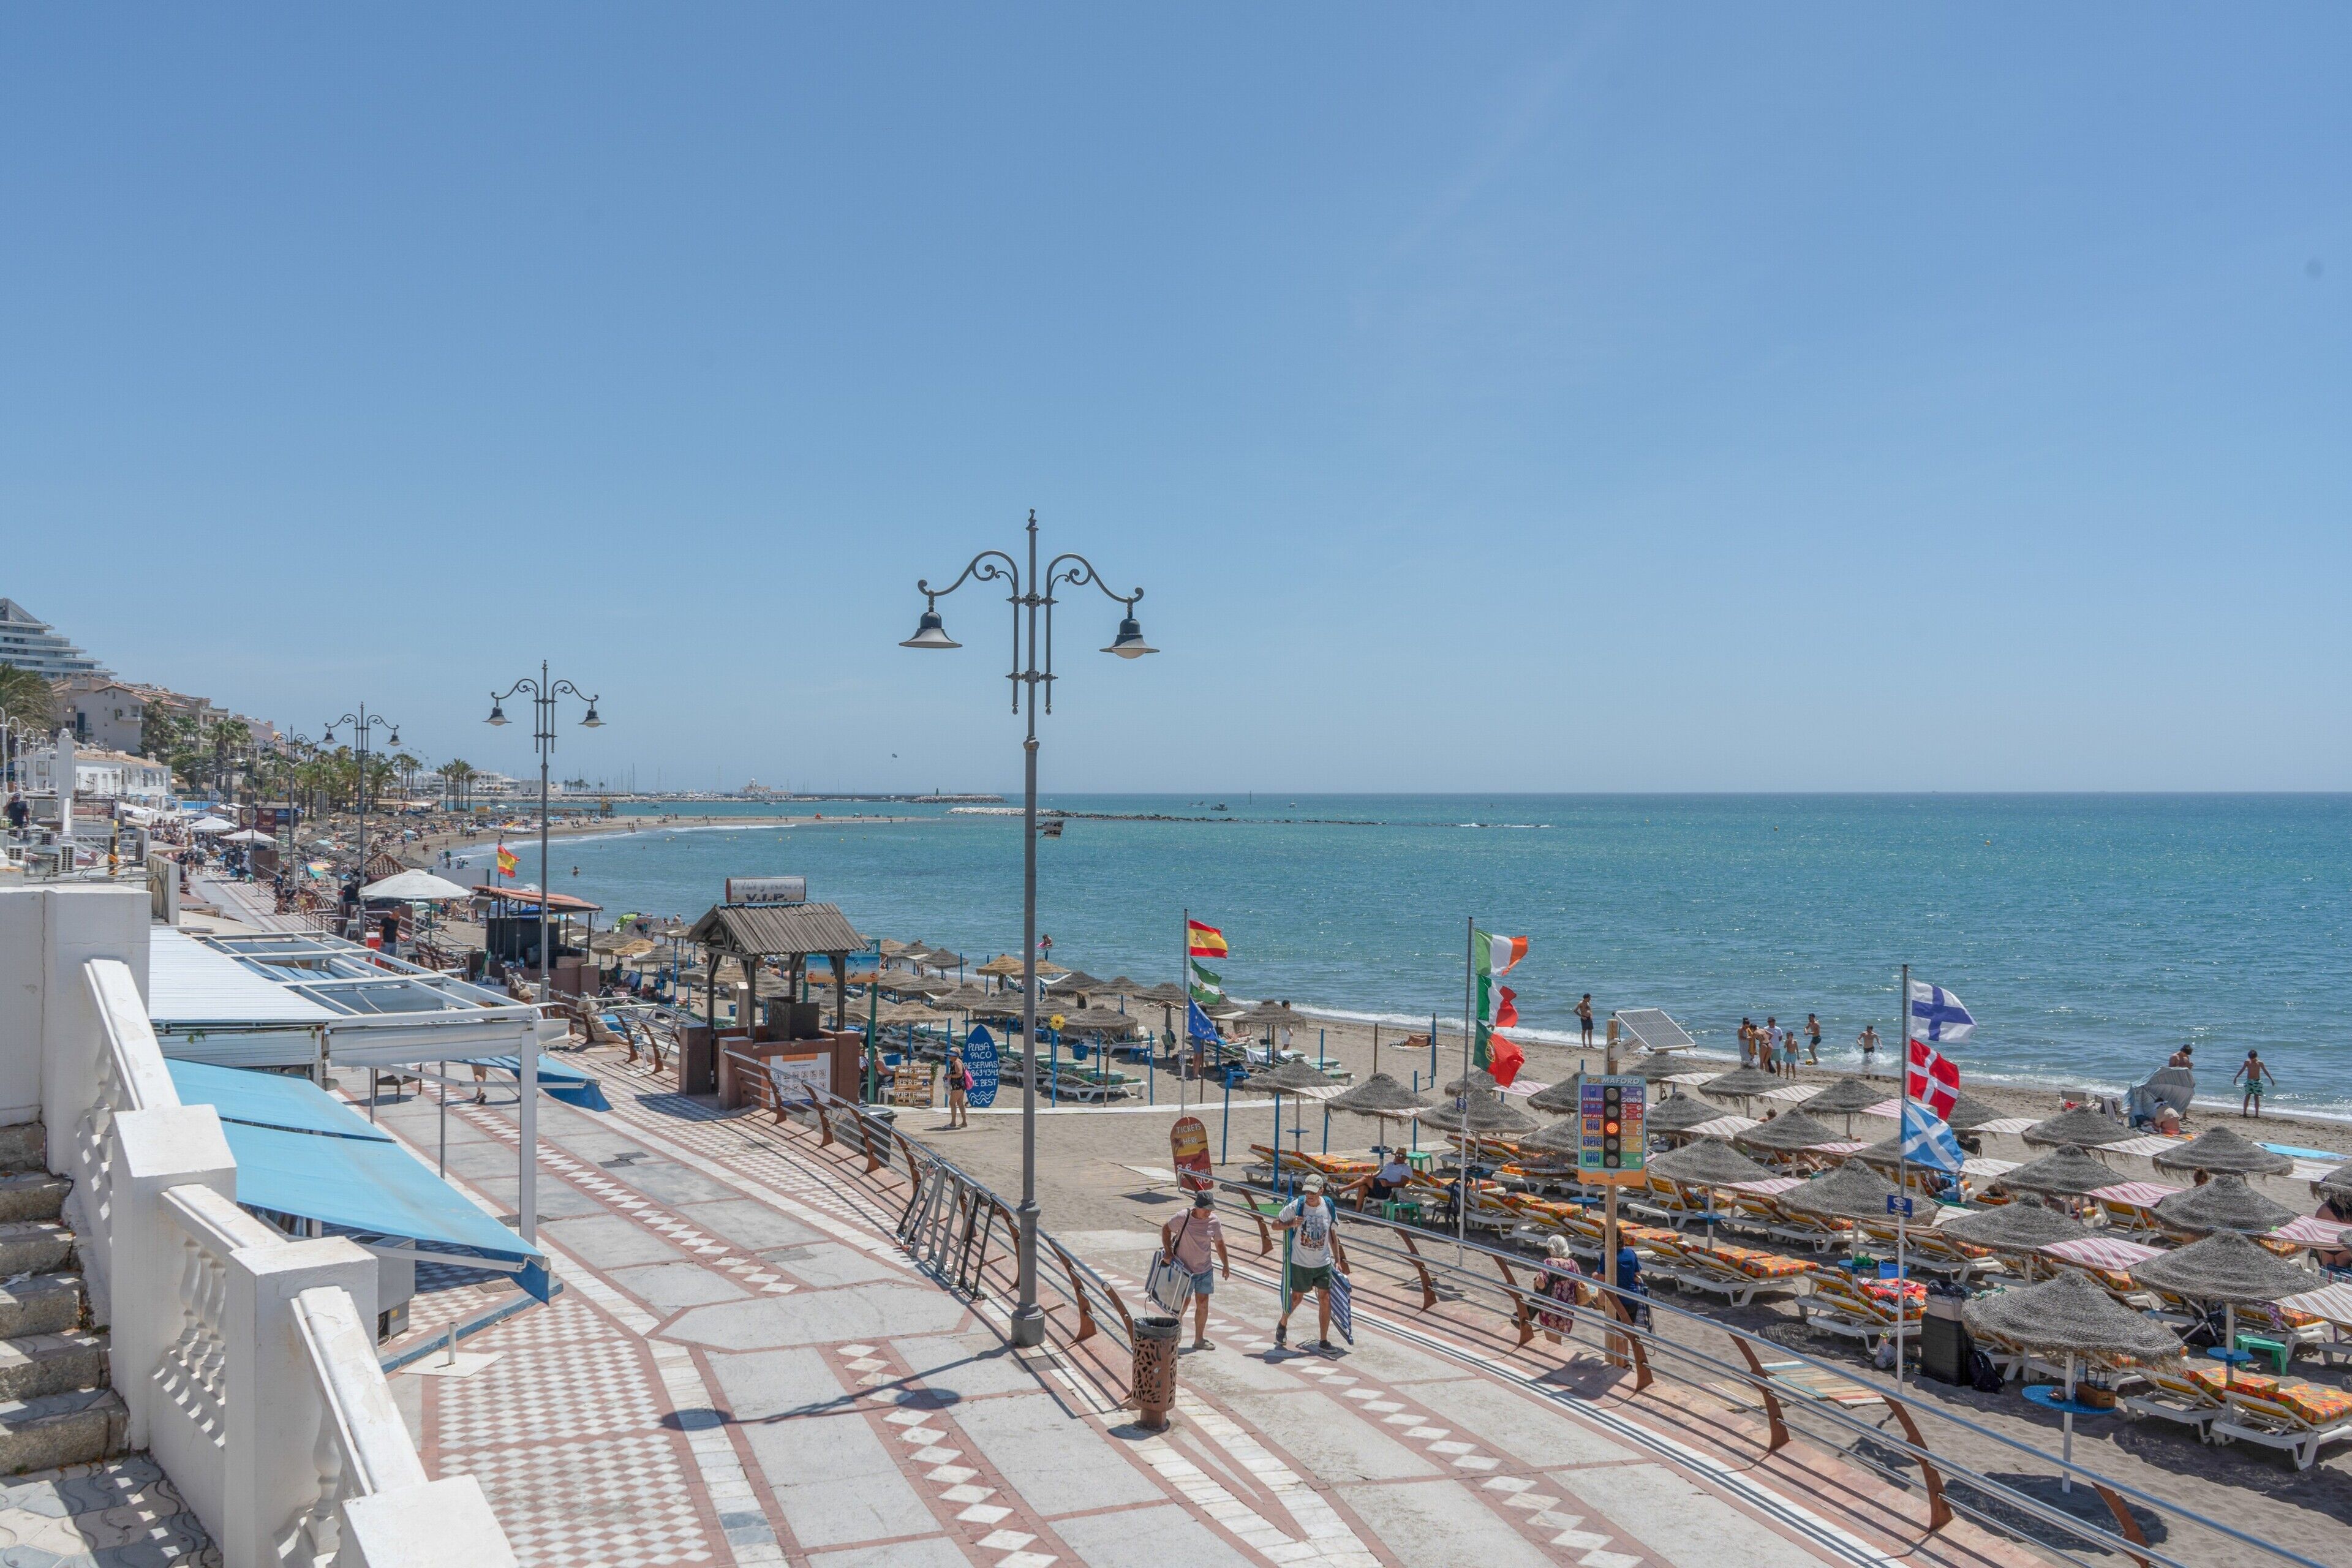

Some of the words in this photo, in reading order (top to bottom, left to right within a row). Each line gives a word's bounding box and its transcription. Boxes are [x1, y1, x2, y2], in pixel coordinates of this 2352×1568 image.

[968, 1042, 990, 1051] PLAYA
[980, 1079, 997, 1087] BEST
[1176, 1123, 1201, 1134] TICKETS
[1183, 1136, 1197, 1145] HERE
